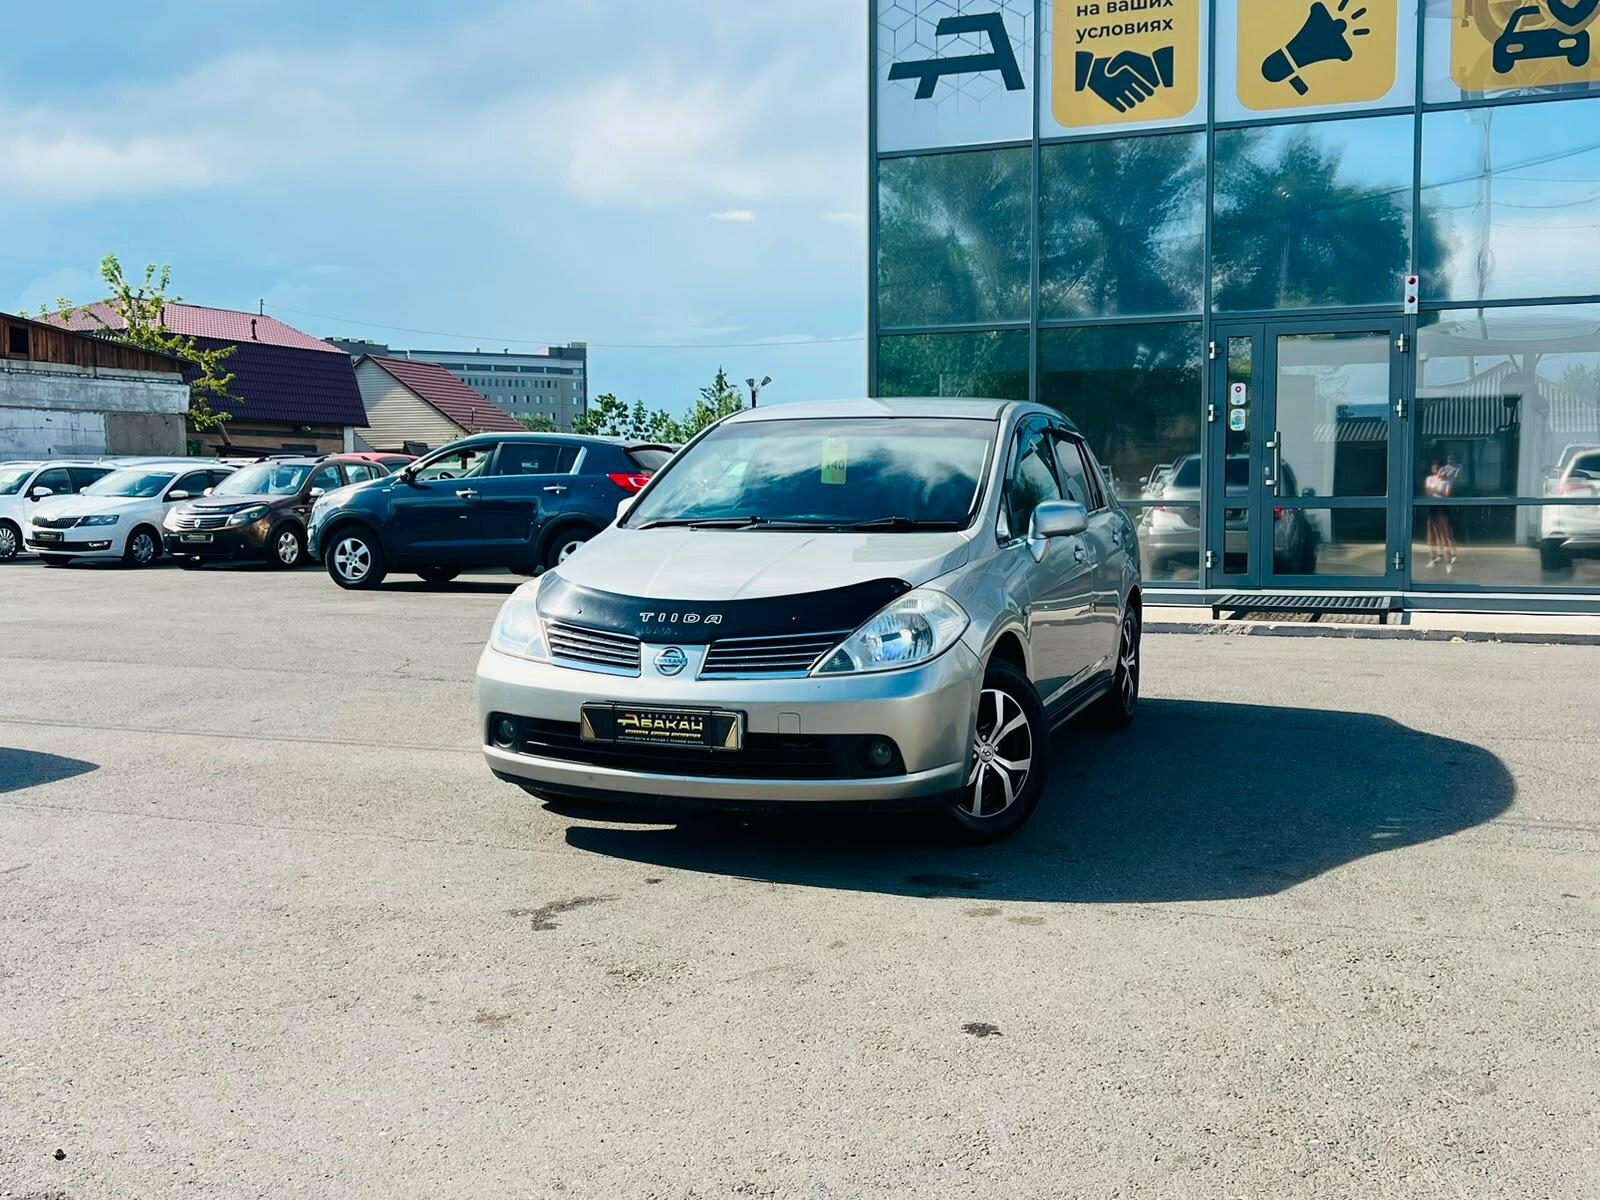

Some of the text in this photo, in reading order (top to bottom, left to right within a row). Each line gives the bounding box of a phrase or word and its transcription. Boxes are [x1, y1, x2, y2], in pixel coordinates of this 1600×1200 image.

[1077, 0, 1174, 17] на ваших
[1076, 18, 1174, 44] условиях
[639, 612, 723, 624] TIIDA
[640, 713, 704, 721] АВТОСАЛОН
